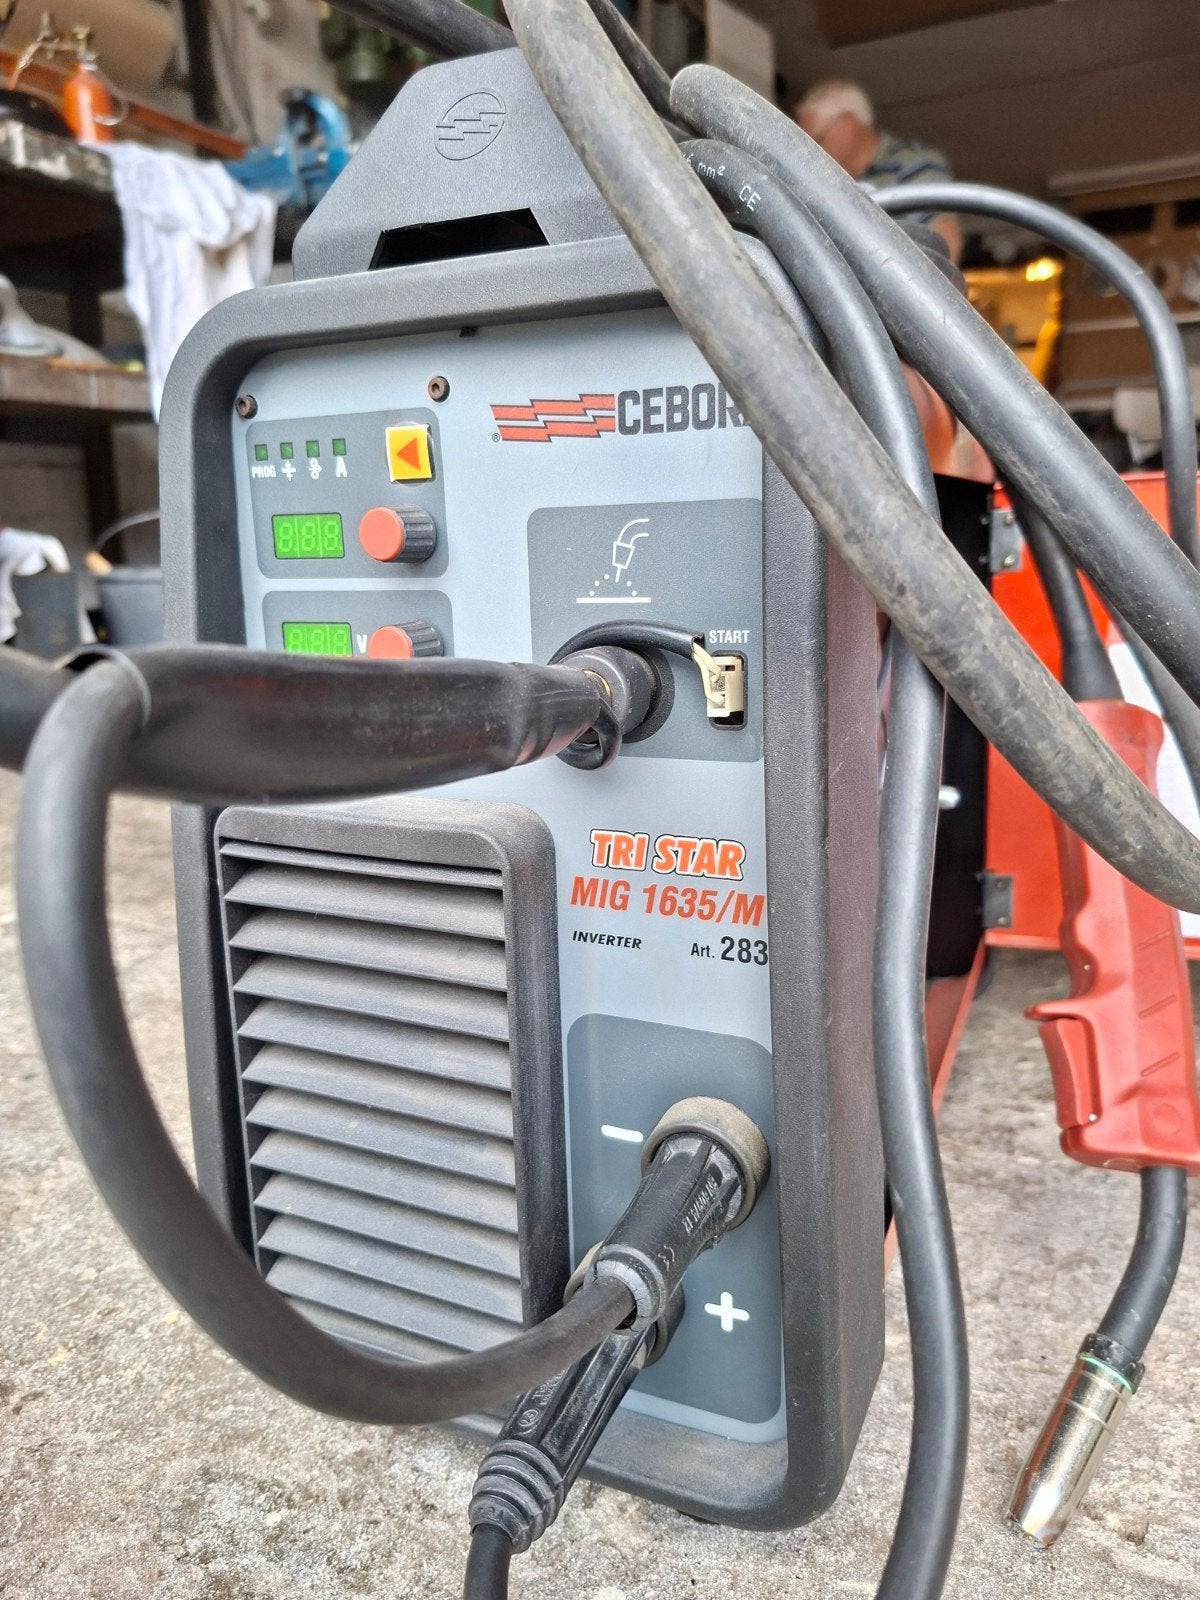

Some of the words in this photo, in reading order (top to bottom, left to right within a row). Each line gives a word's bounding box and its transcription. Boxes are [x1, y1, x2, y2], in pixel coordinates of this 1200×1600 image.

[739, 185, 761, 212] CE
[617, 382, 750, 436] CEBOR
[252, 465, 276, 479] PROG
[336, 456, 348, 478] A
[356, 633, 368, 654] V
[708, 630, 750, 644] START
[590, 829, 650, 872] TRI
[651, 834, 747, 882] STAR
[570, 876, 631, 911] MIG
[642, 884, 765, 927] 1635/M
[572, 930, 642, 949] INVERTER
[690, 942, 715, 958] Art.
[720, 936, 768, 966] 283
